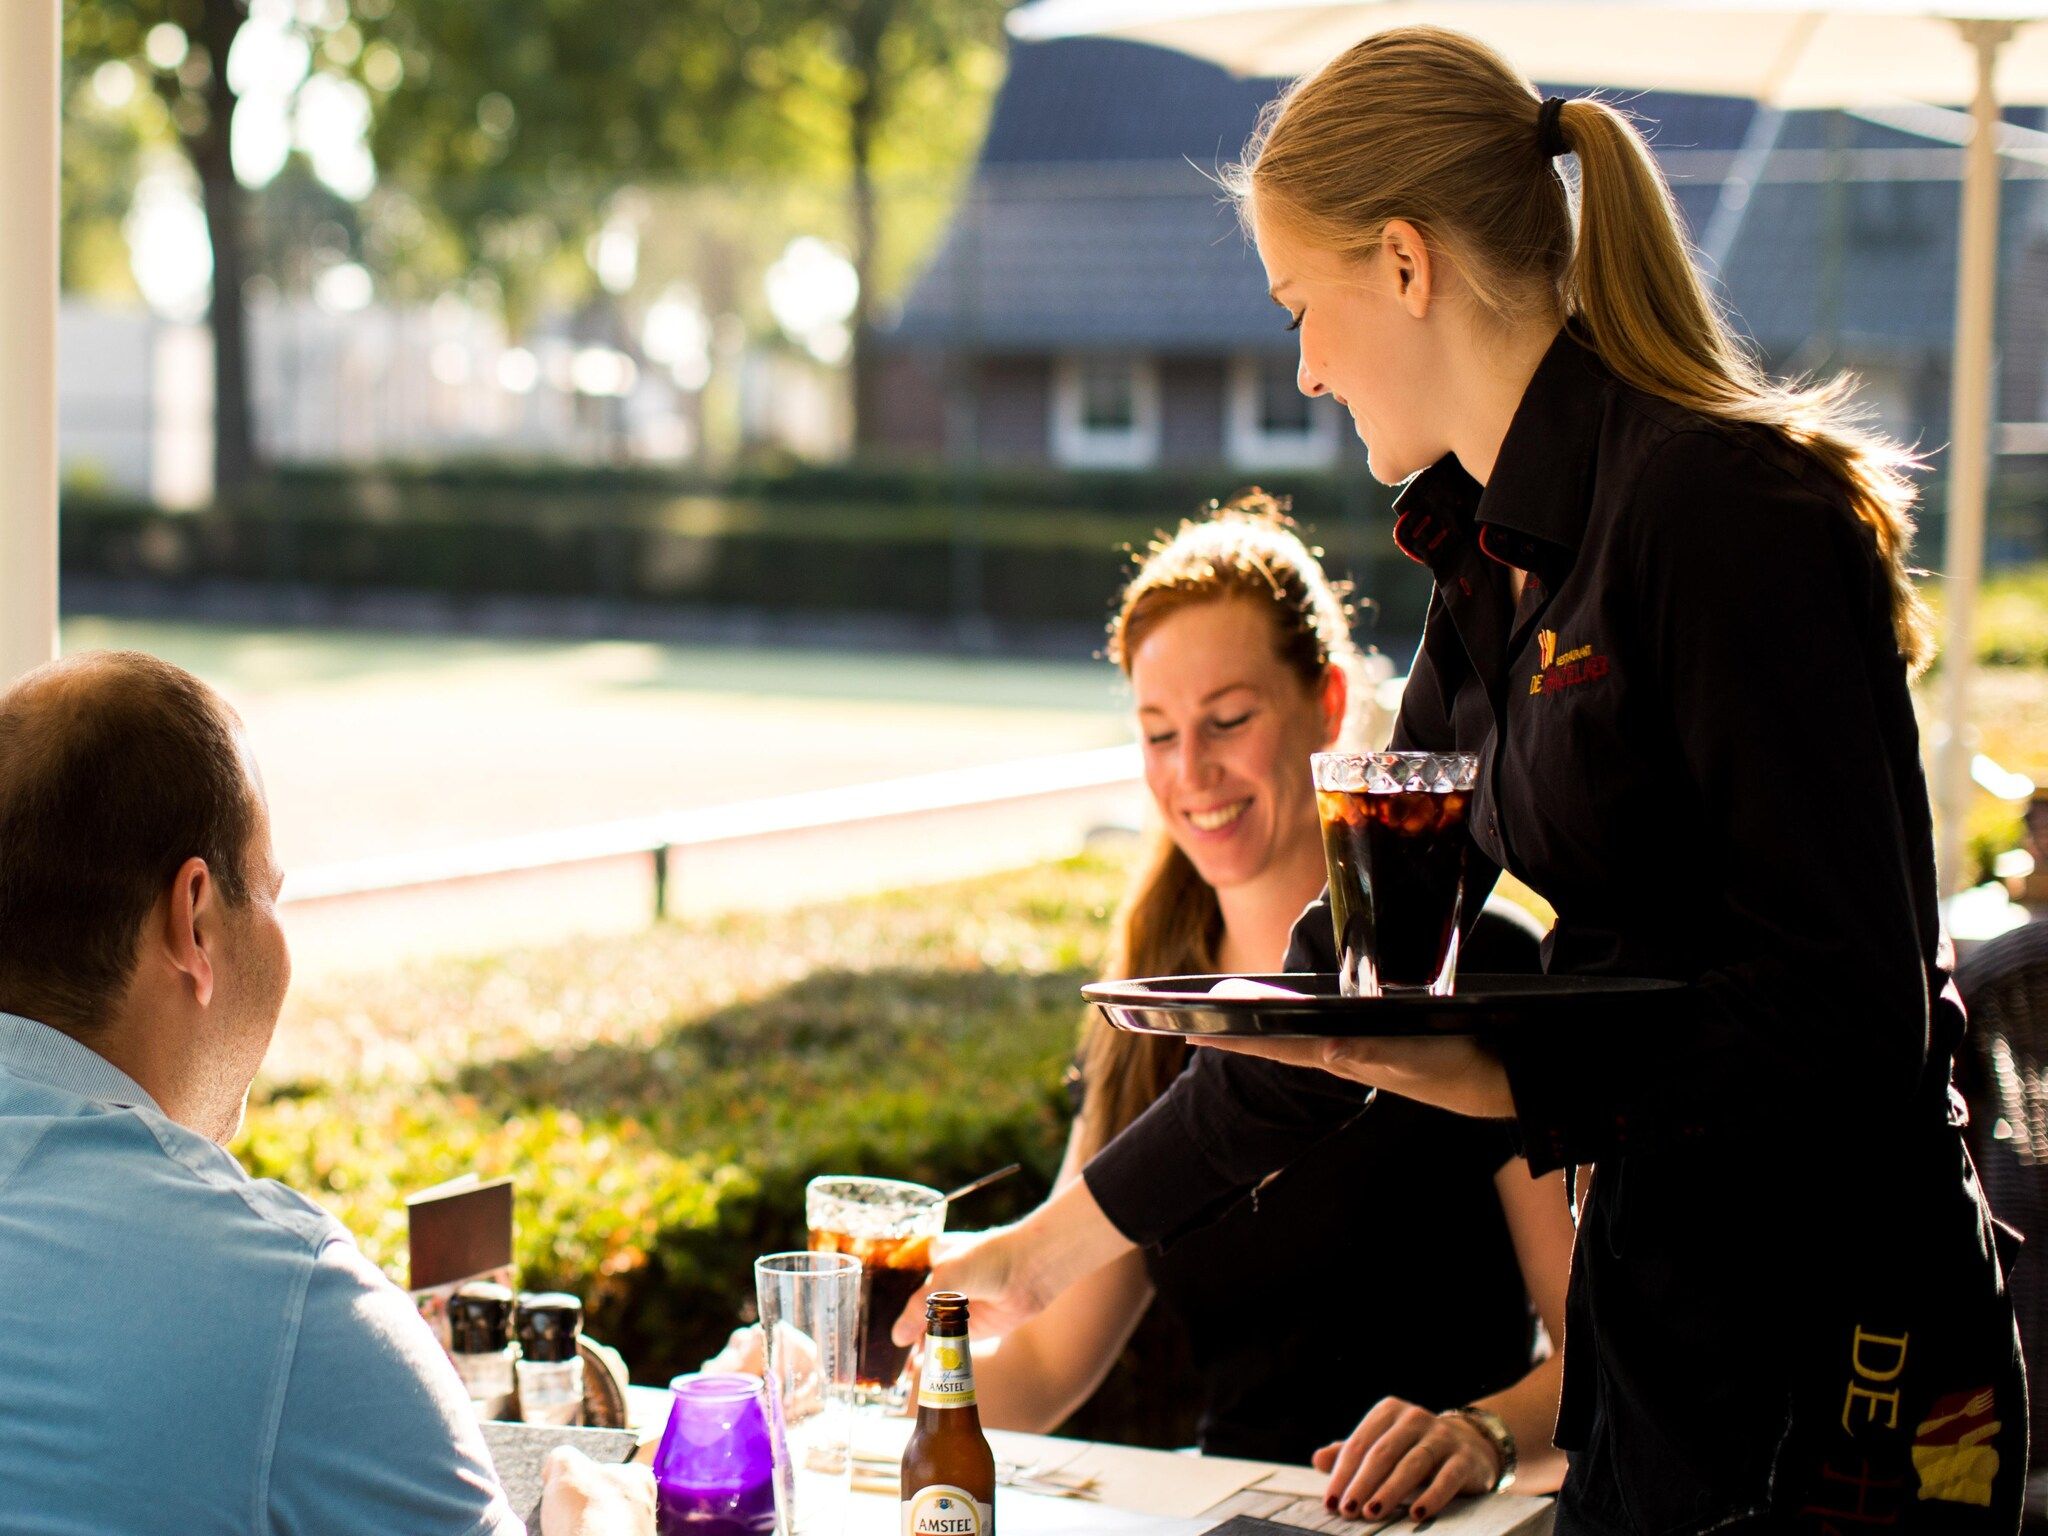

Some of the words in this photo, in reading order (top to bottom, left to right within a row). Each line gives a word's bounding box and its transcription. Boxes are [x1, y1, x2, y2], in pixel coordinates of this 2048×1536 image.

[1530, 674, 1544, 695] DE
[929, 1382, 966, 1393] AMSTEL
[1841, 1324, 1909, 1438] DE
[918, 1518, 972, 1533] AMSTEL
